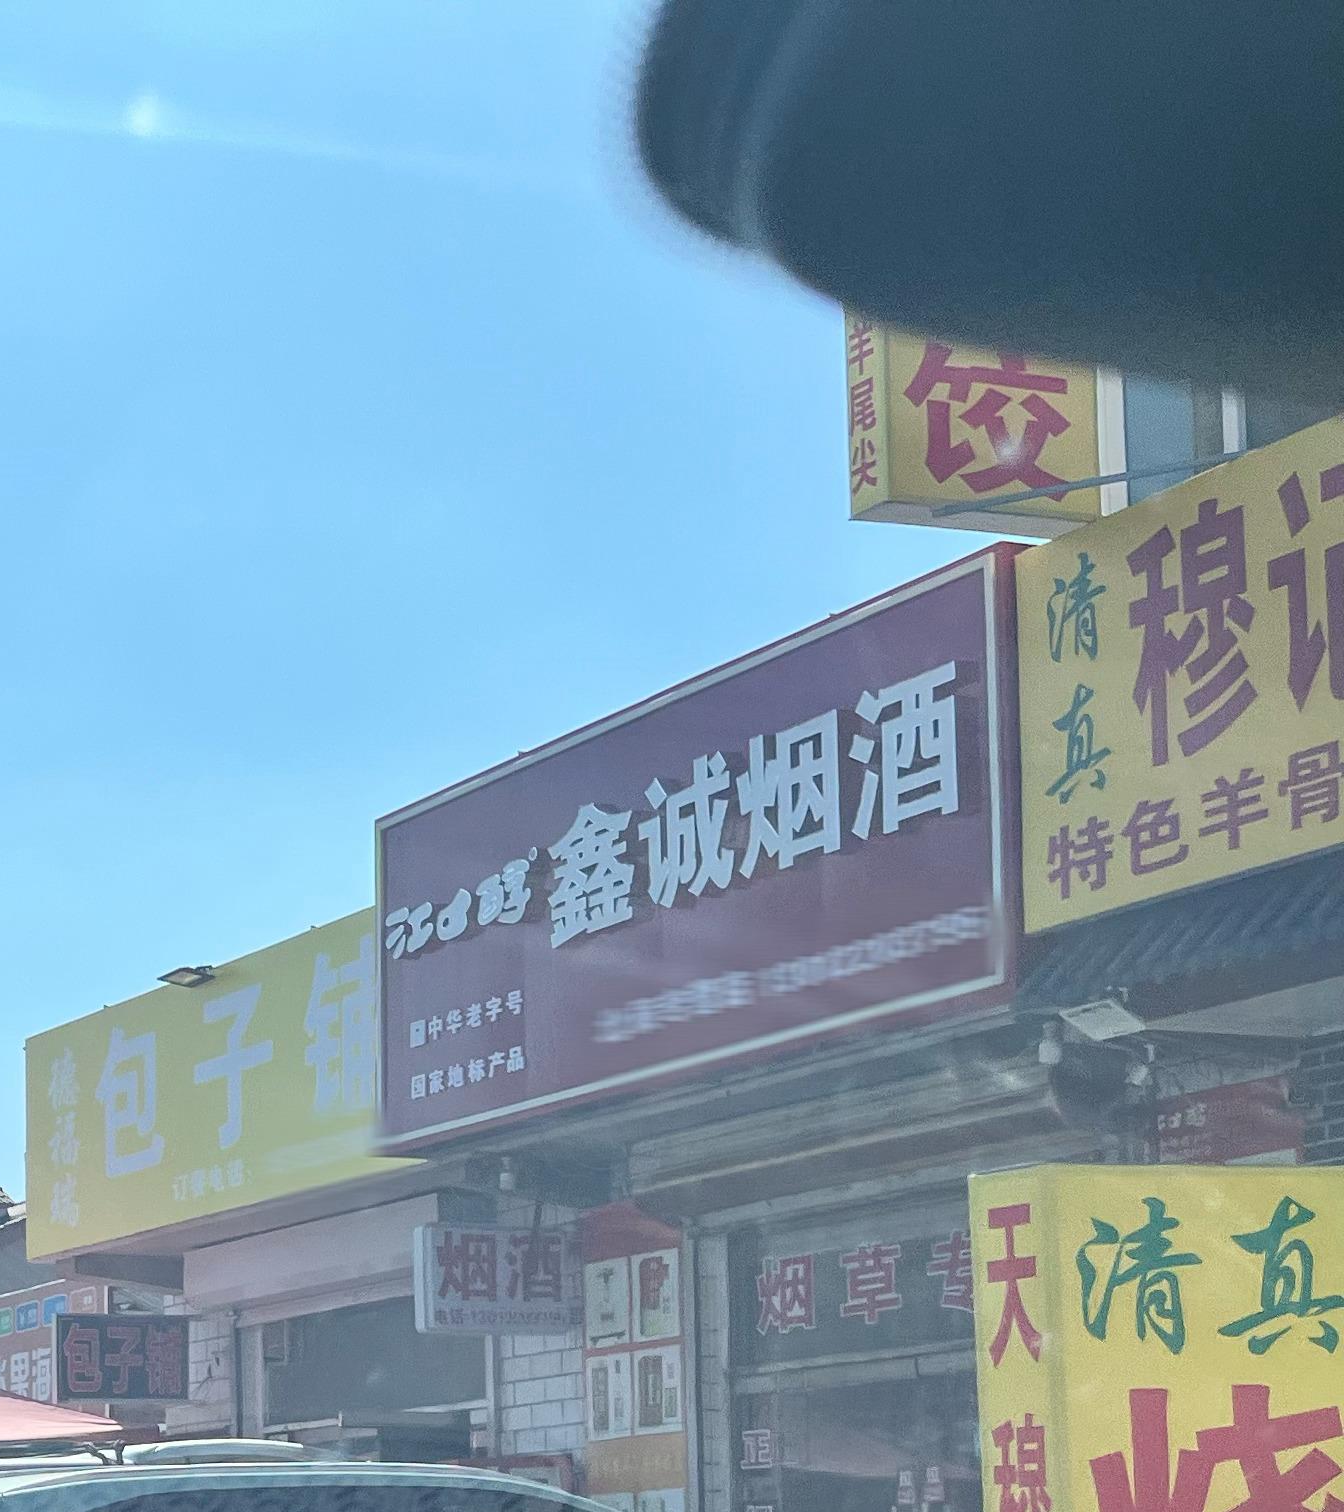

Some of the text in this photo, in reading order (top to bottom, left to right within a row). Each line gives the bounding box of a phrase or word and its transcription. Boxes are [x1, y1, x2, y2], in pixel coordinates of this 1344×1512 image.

[847, 322, 879, 497] 羊尾尖
[903, 340, 1072, 502] 饺
[1046, 552, 1111, 804] 清真
[548, 660, 959, 949] 鑫诚烟酒
[1046, 740, 1344, 899] 特色羊骨
[94, 933, 375, 1180] 包子铺
[411, 1045, 526, 1101] 国家地标产品
[436, 1230, 562, 1303] 烟酒
[1075, 1195, 1344, 1357] 清真
